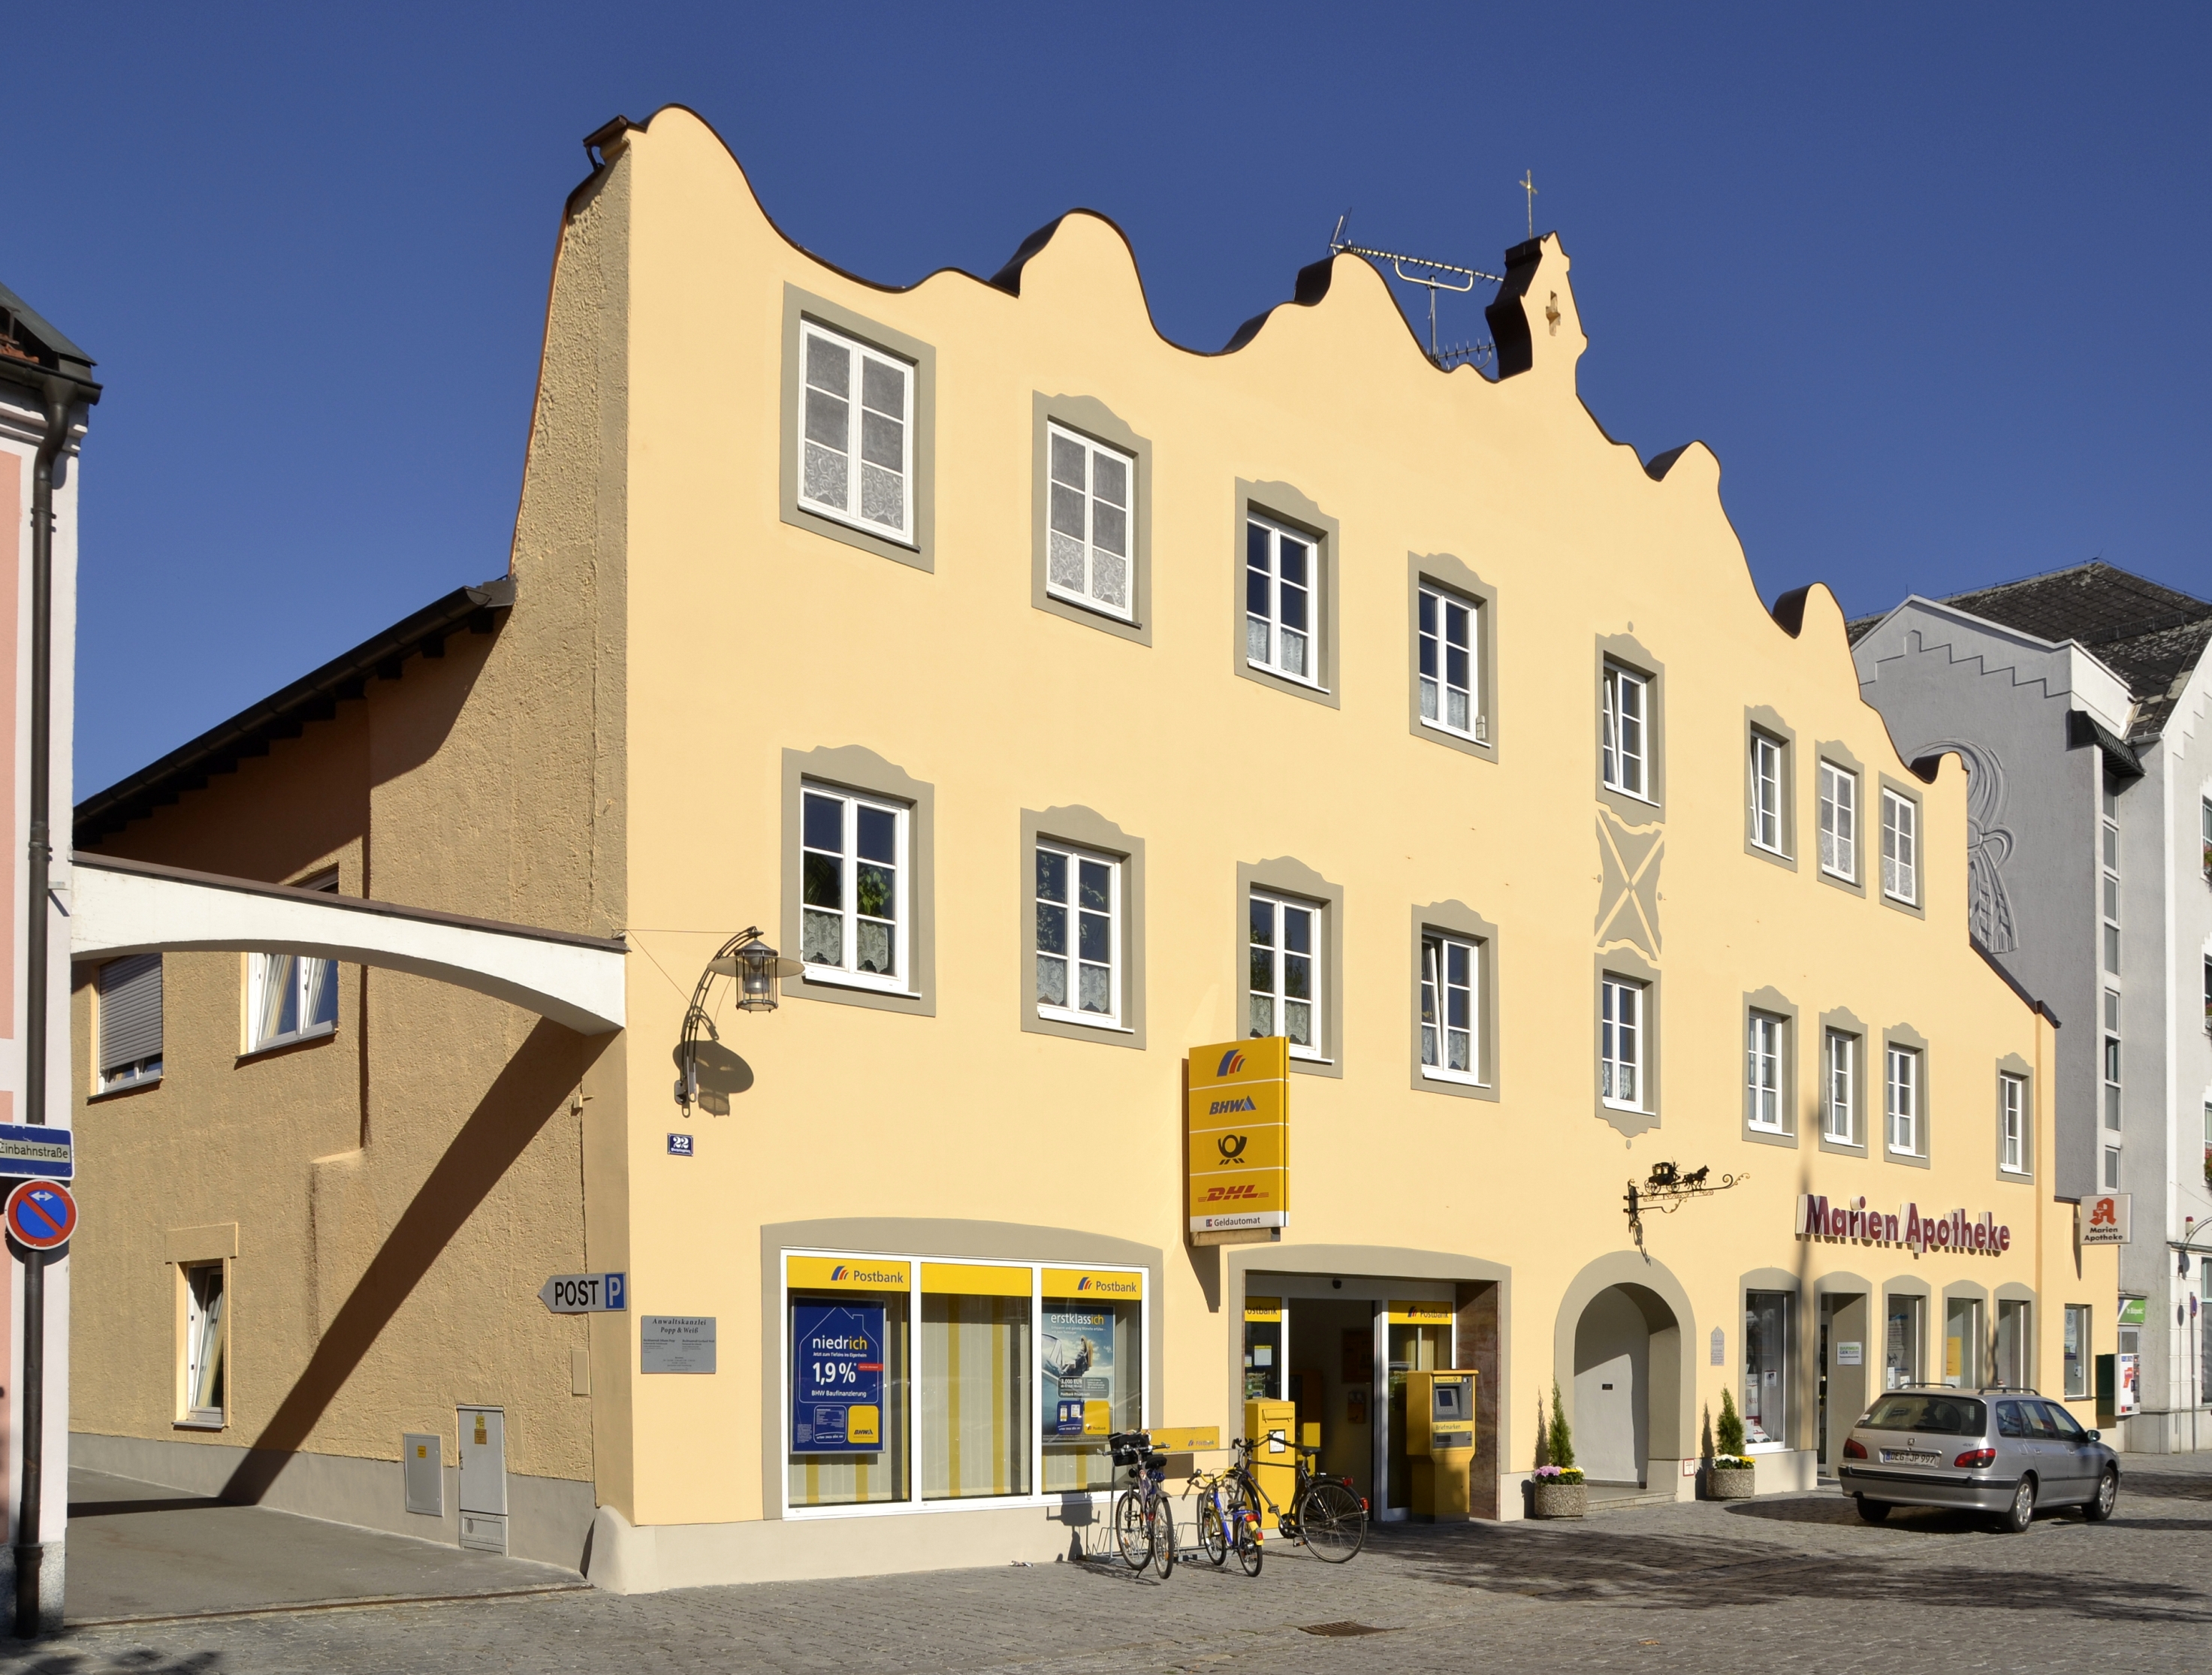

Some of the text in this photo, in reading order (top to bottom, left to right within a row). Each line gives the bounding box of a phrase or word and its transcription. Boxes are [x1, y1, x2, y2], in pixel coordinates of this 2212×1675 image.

[1209, 1097, 1247, 1115] BHW
[673, 1136, 689, 1148] 22
[1207, 1185, 1258, 1202] DHL
[1214, 1217, 1260, 1227] Geldautomat
[1800, 1194, 2011, 1253] Marien Apotheke
[2084, 1234, 2123, 1242] Apotheke
[853, 1270, 904, 1284] Postbank
[555, 1278, 621, 1306] POST P
[1096, 1281, 1136, 1293] Postbank
[1051, 1313, 1104, 1325] erstklassich
[1420, 1309, 1449, 1319] Postbank
[813, 1335, 868, 1350] niedrich
[1891, 1451, 1936, 1463] DEG JP 997
